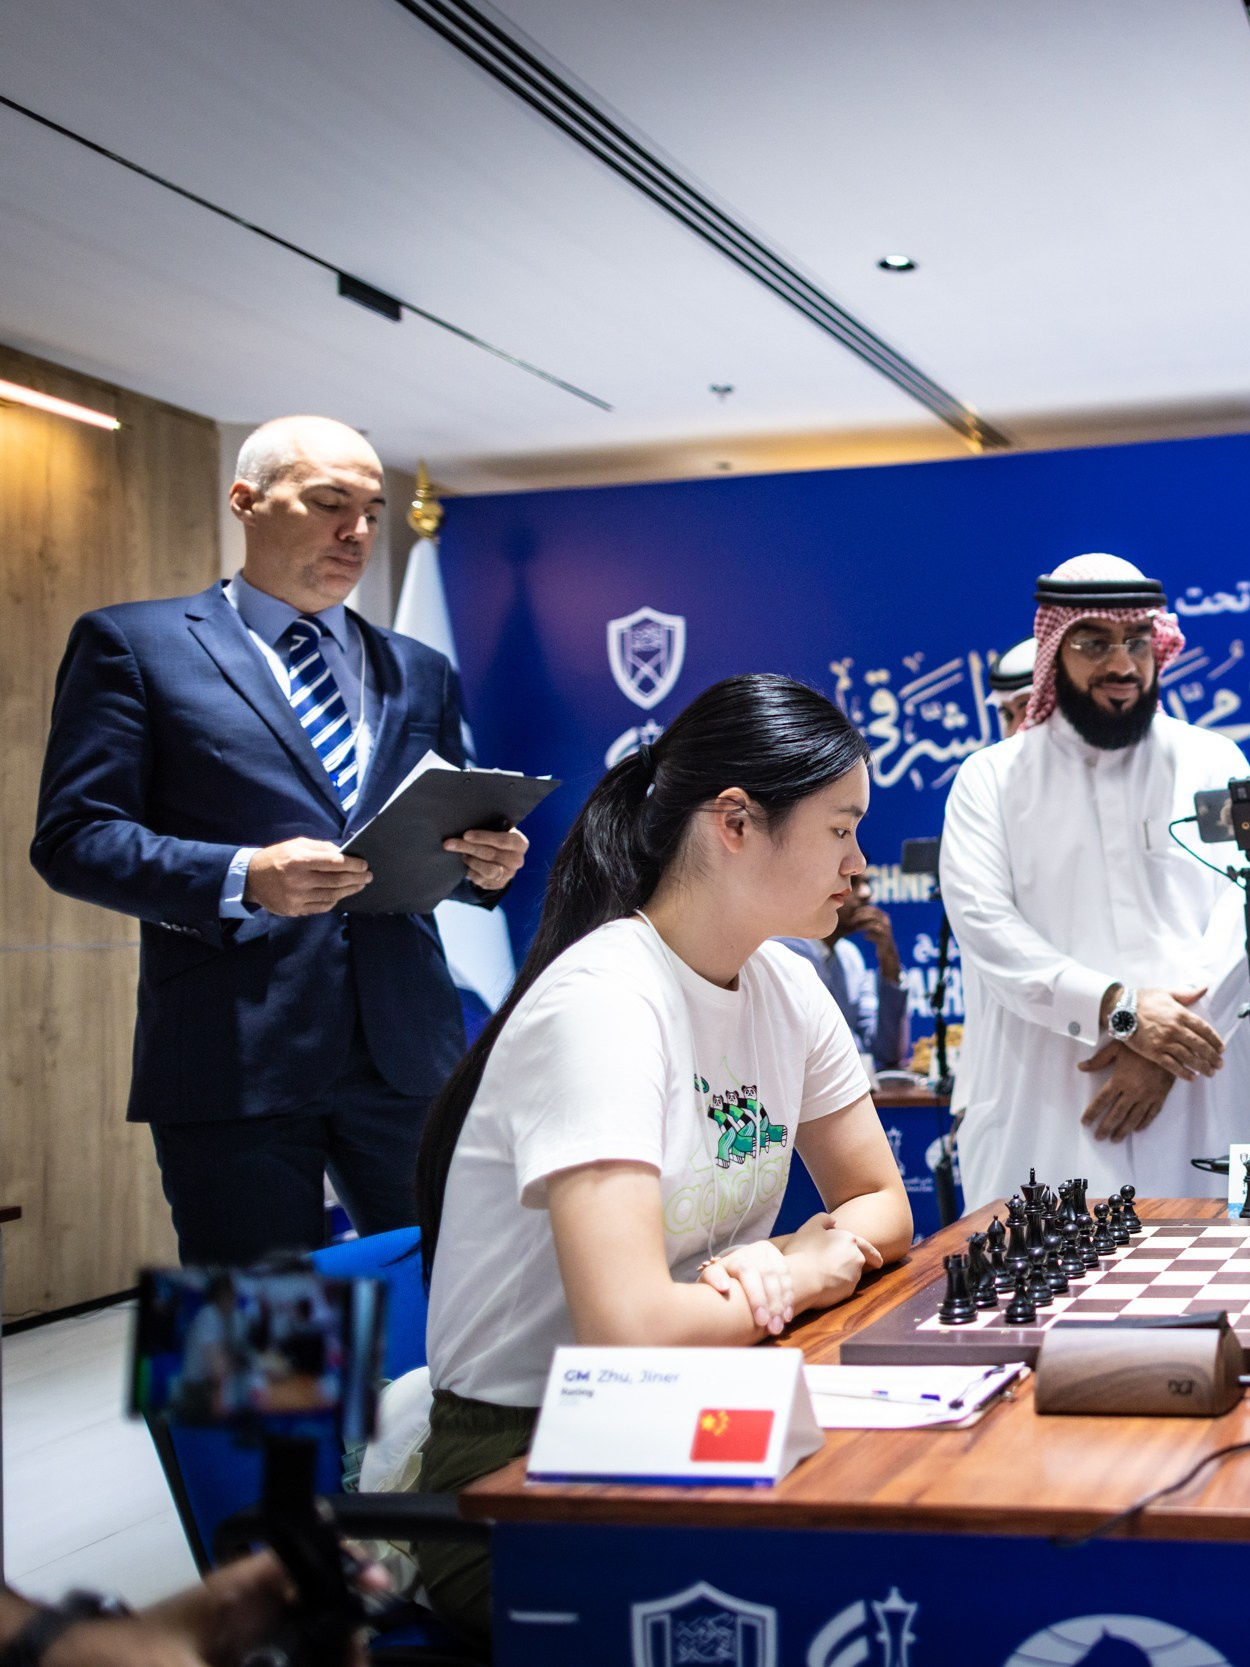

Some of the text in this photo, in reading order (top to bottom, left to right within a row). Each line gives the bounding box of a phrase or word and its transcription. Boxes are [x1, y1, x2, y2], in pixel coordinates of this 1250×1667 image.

[663, 1152, 791, 1236] adida
[564, 1369, 680, 1384] GM Zhu, Jiner
